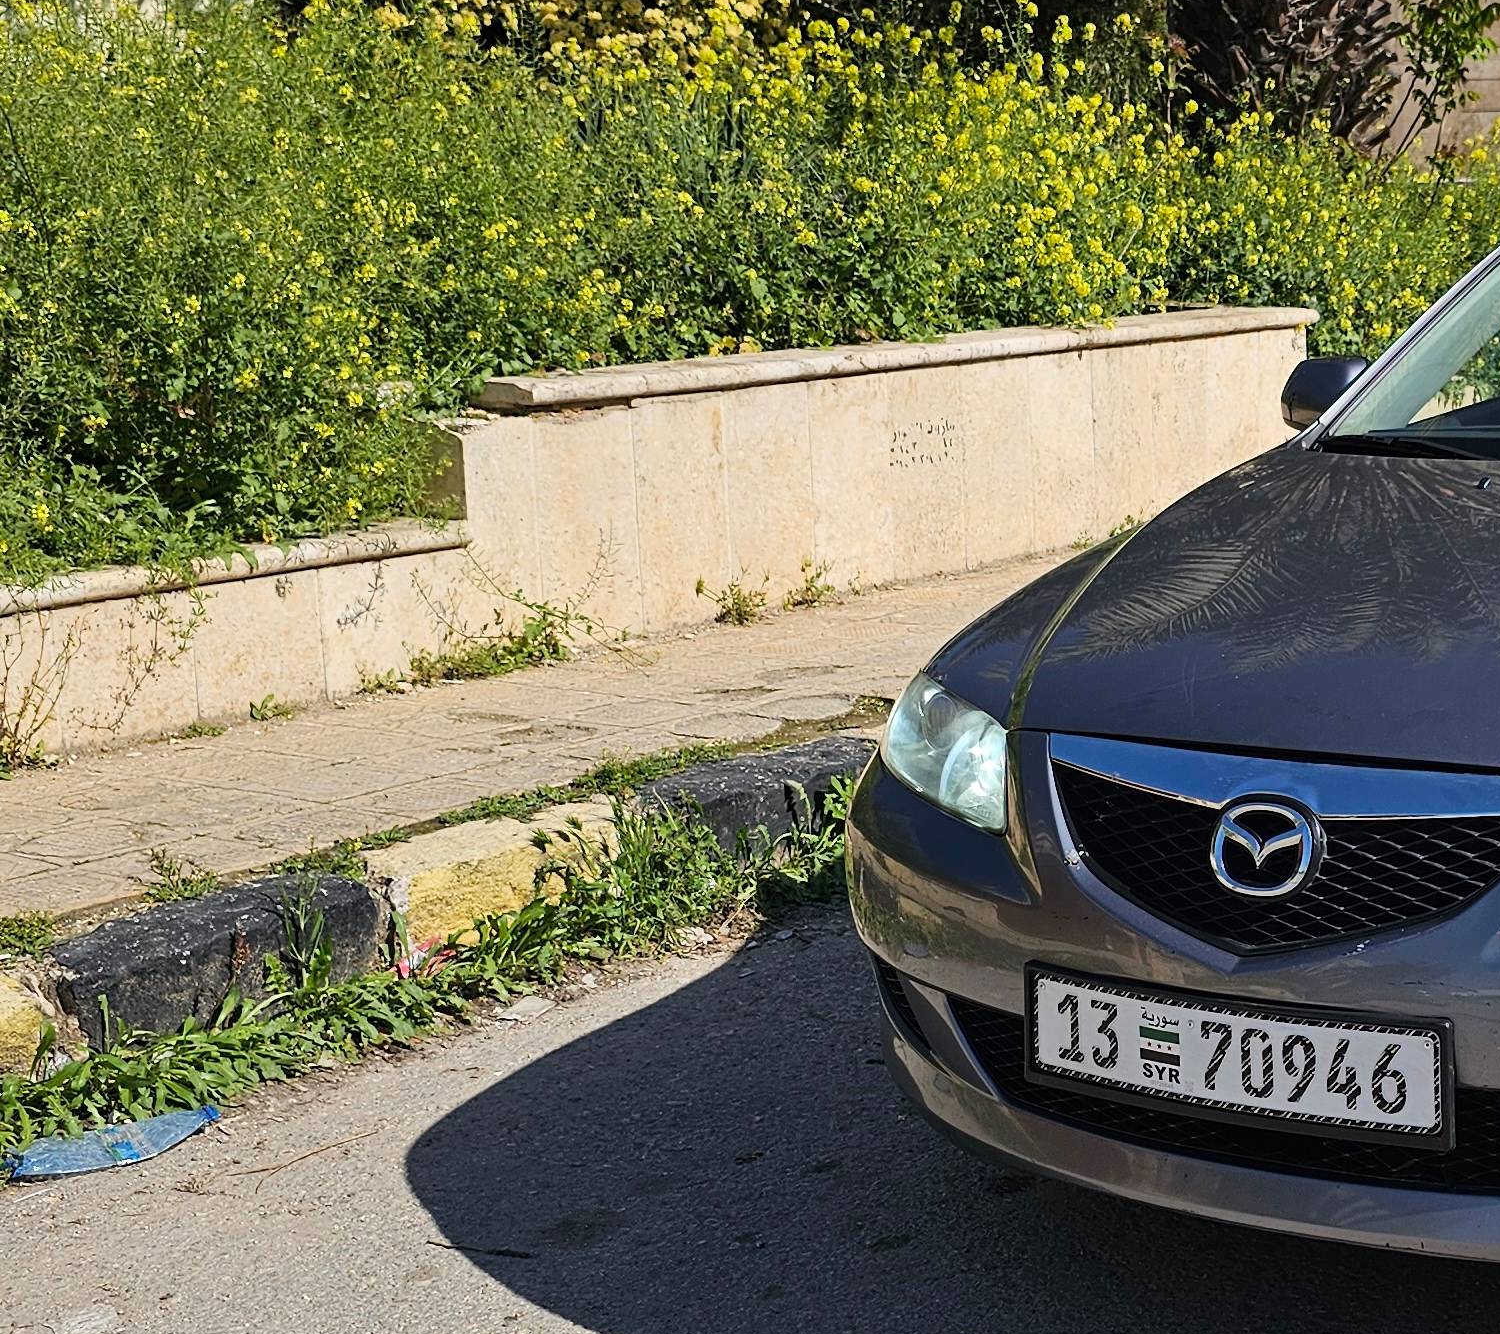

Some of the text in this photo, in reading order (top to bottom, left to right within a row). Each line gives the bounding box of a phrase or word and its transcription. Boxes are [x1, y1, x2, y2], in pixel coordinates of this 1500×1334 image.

[1141, 1006, 1180, 1028] سورية
[1057, 993, 1408, 1114] 13 70946
[1142, 1062, 1181, 1085] SYR
